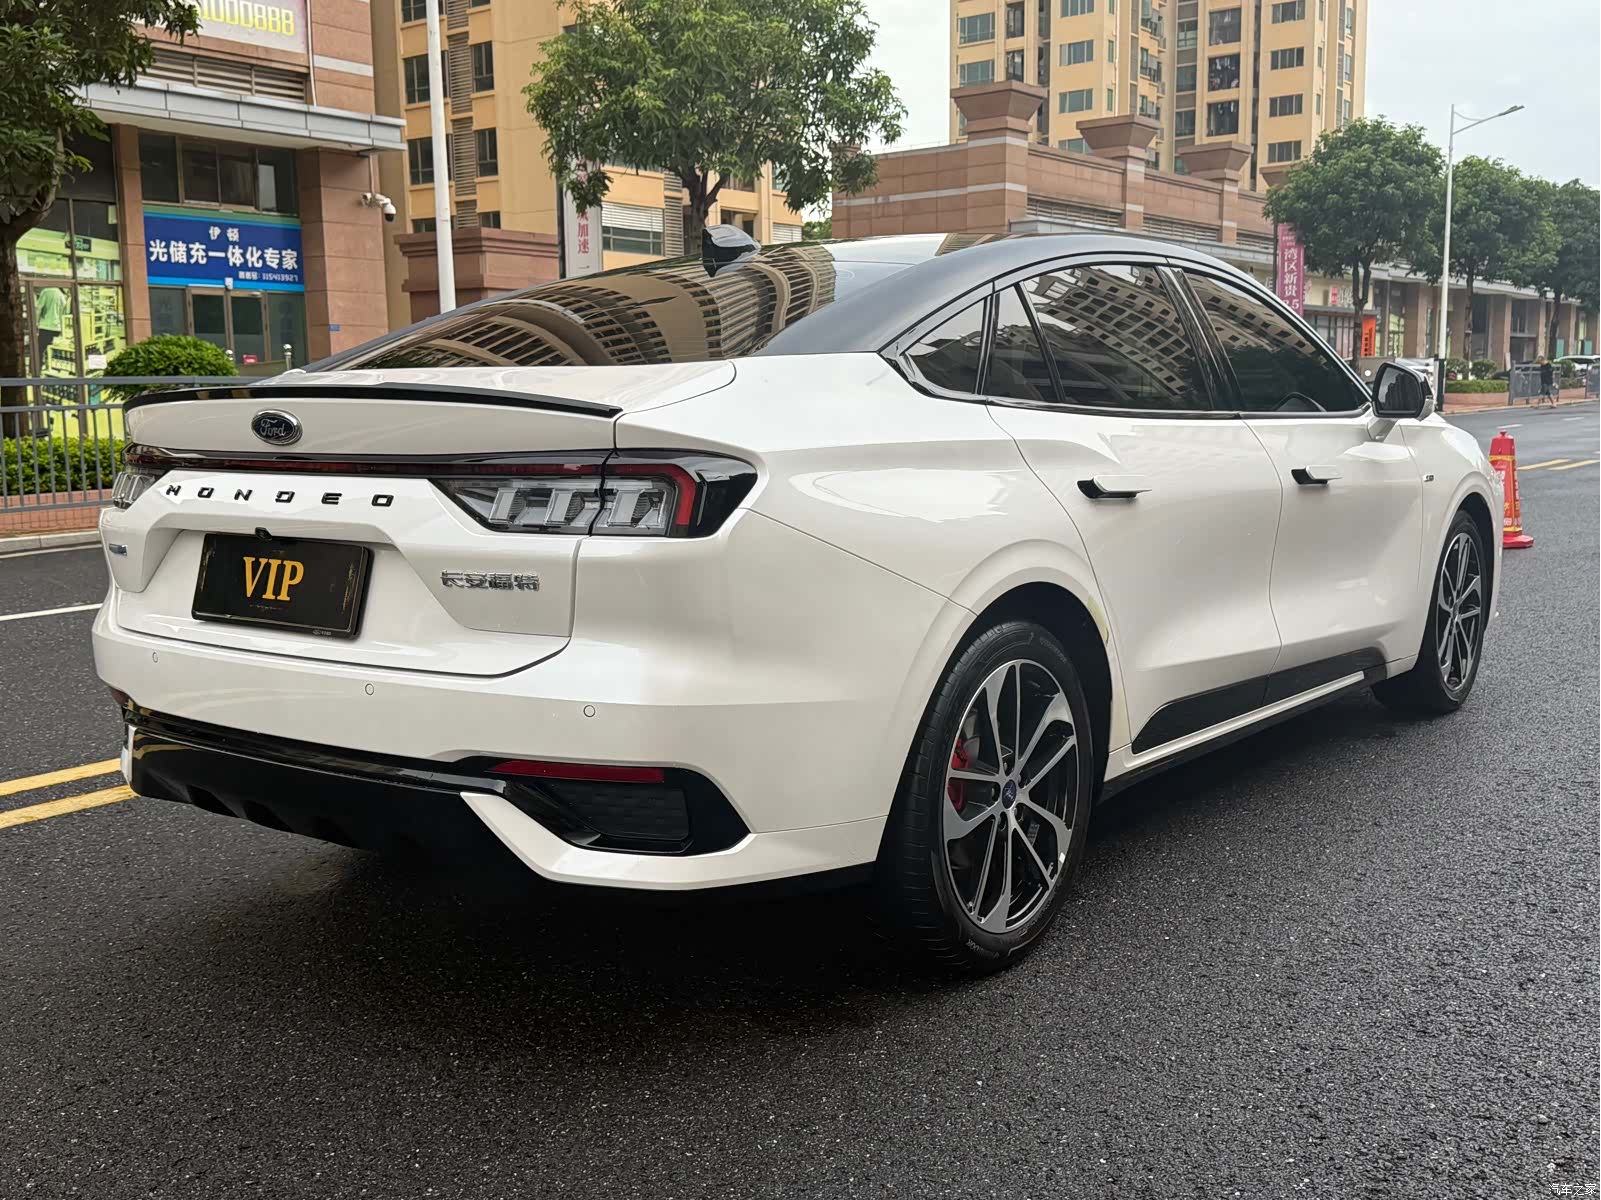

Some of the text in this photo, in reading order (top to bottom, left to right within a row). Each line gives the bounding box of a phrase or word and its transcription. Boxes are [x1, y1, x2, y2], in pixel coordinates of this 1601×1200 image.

[149, 239, 298, 270] 光储充一体化专家
[1283, 247, 1298, 297] 湾区新贵
[259, 418, 286, 437] Ford
[166, 484, 394, 508] MONDEO
[243, 556, 305, 601] VIP
[441, 570, 540, 591] 长安福特
